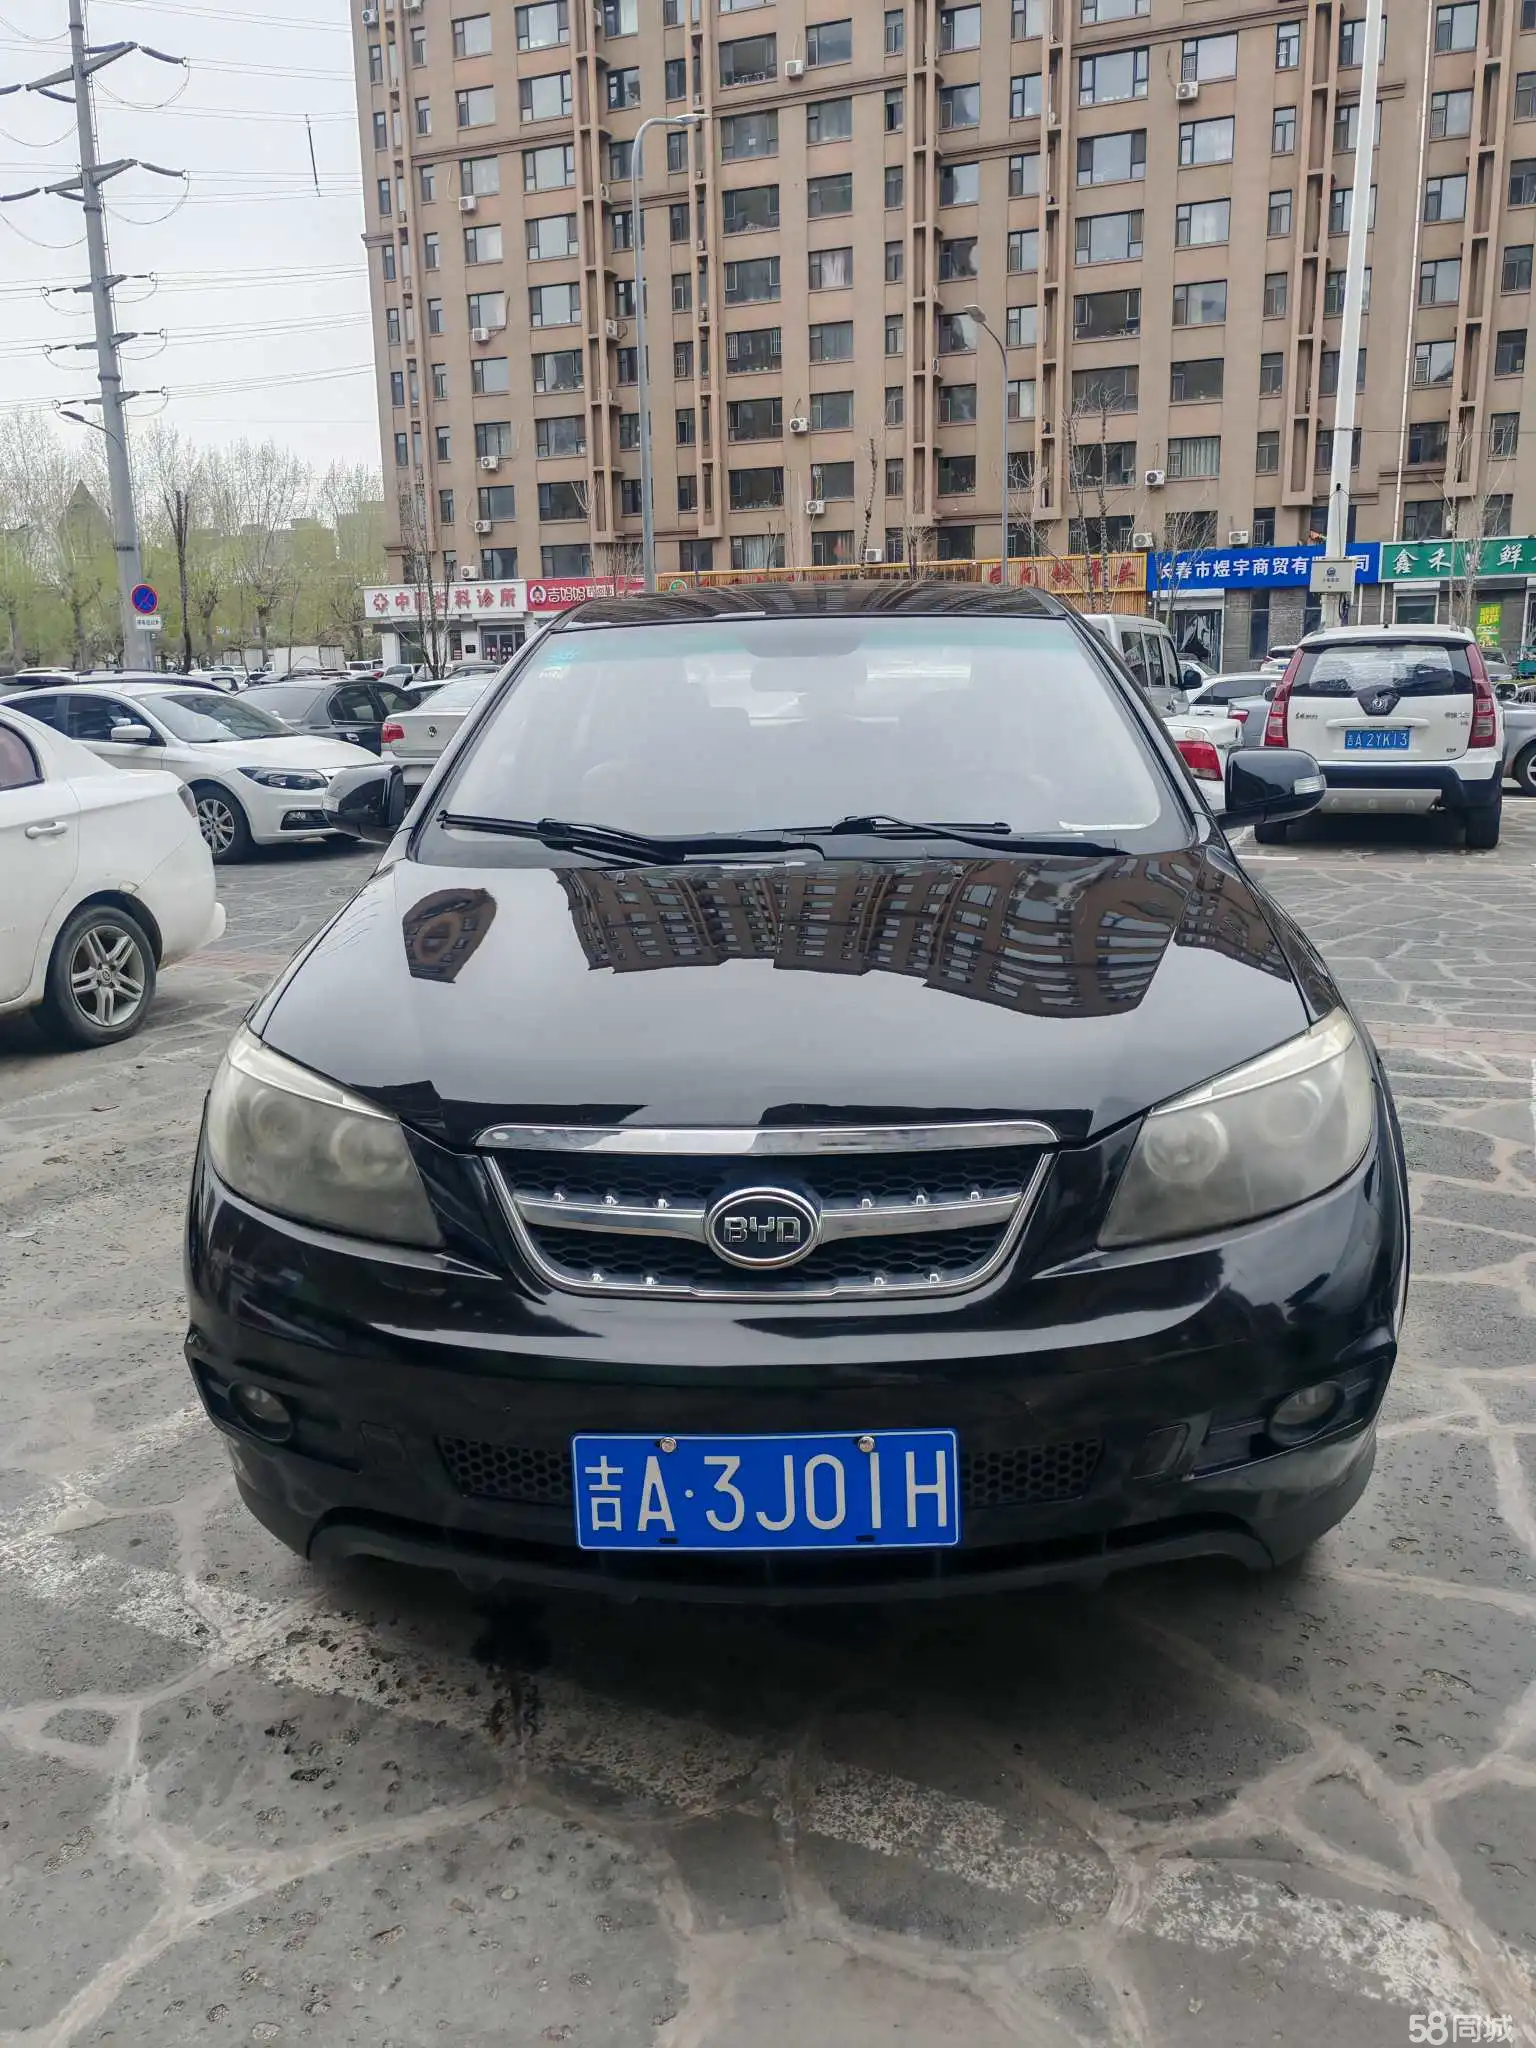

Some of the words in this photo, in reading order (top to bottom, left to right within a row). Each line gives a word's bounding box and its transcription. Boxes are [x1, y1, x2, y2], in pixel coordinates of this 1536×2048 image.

[1159, 555, 1370, 579] 长春市煜宇商贸有司
[1392, 543, 1536, 574] 鑫禾鲜
[724, 1216, 801, 1243] BYD
